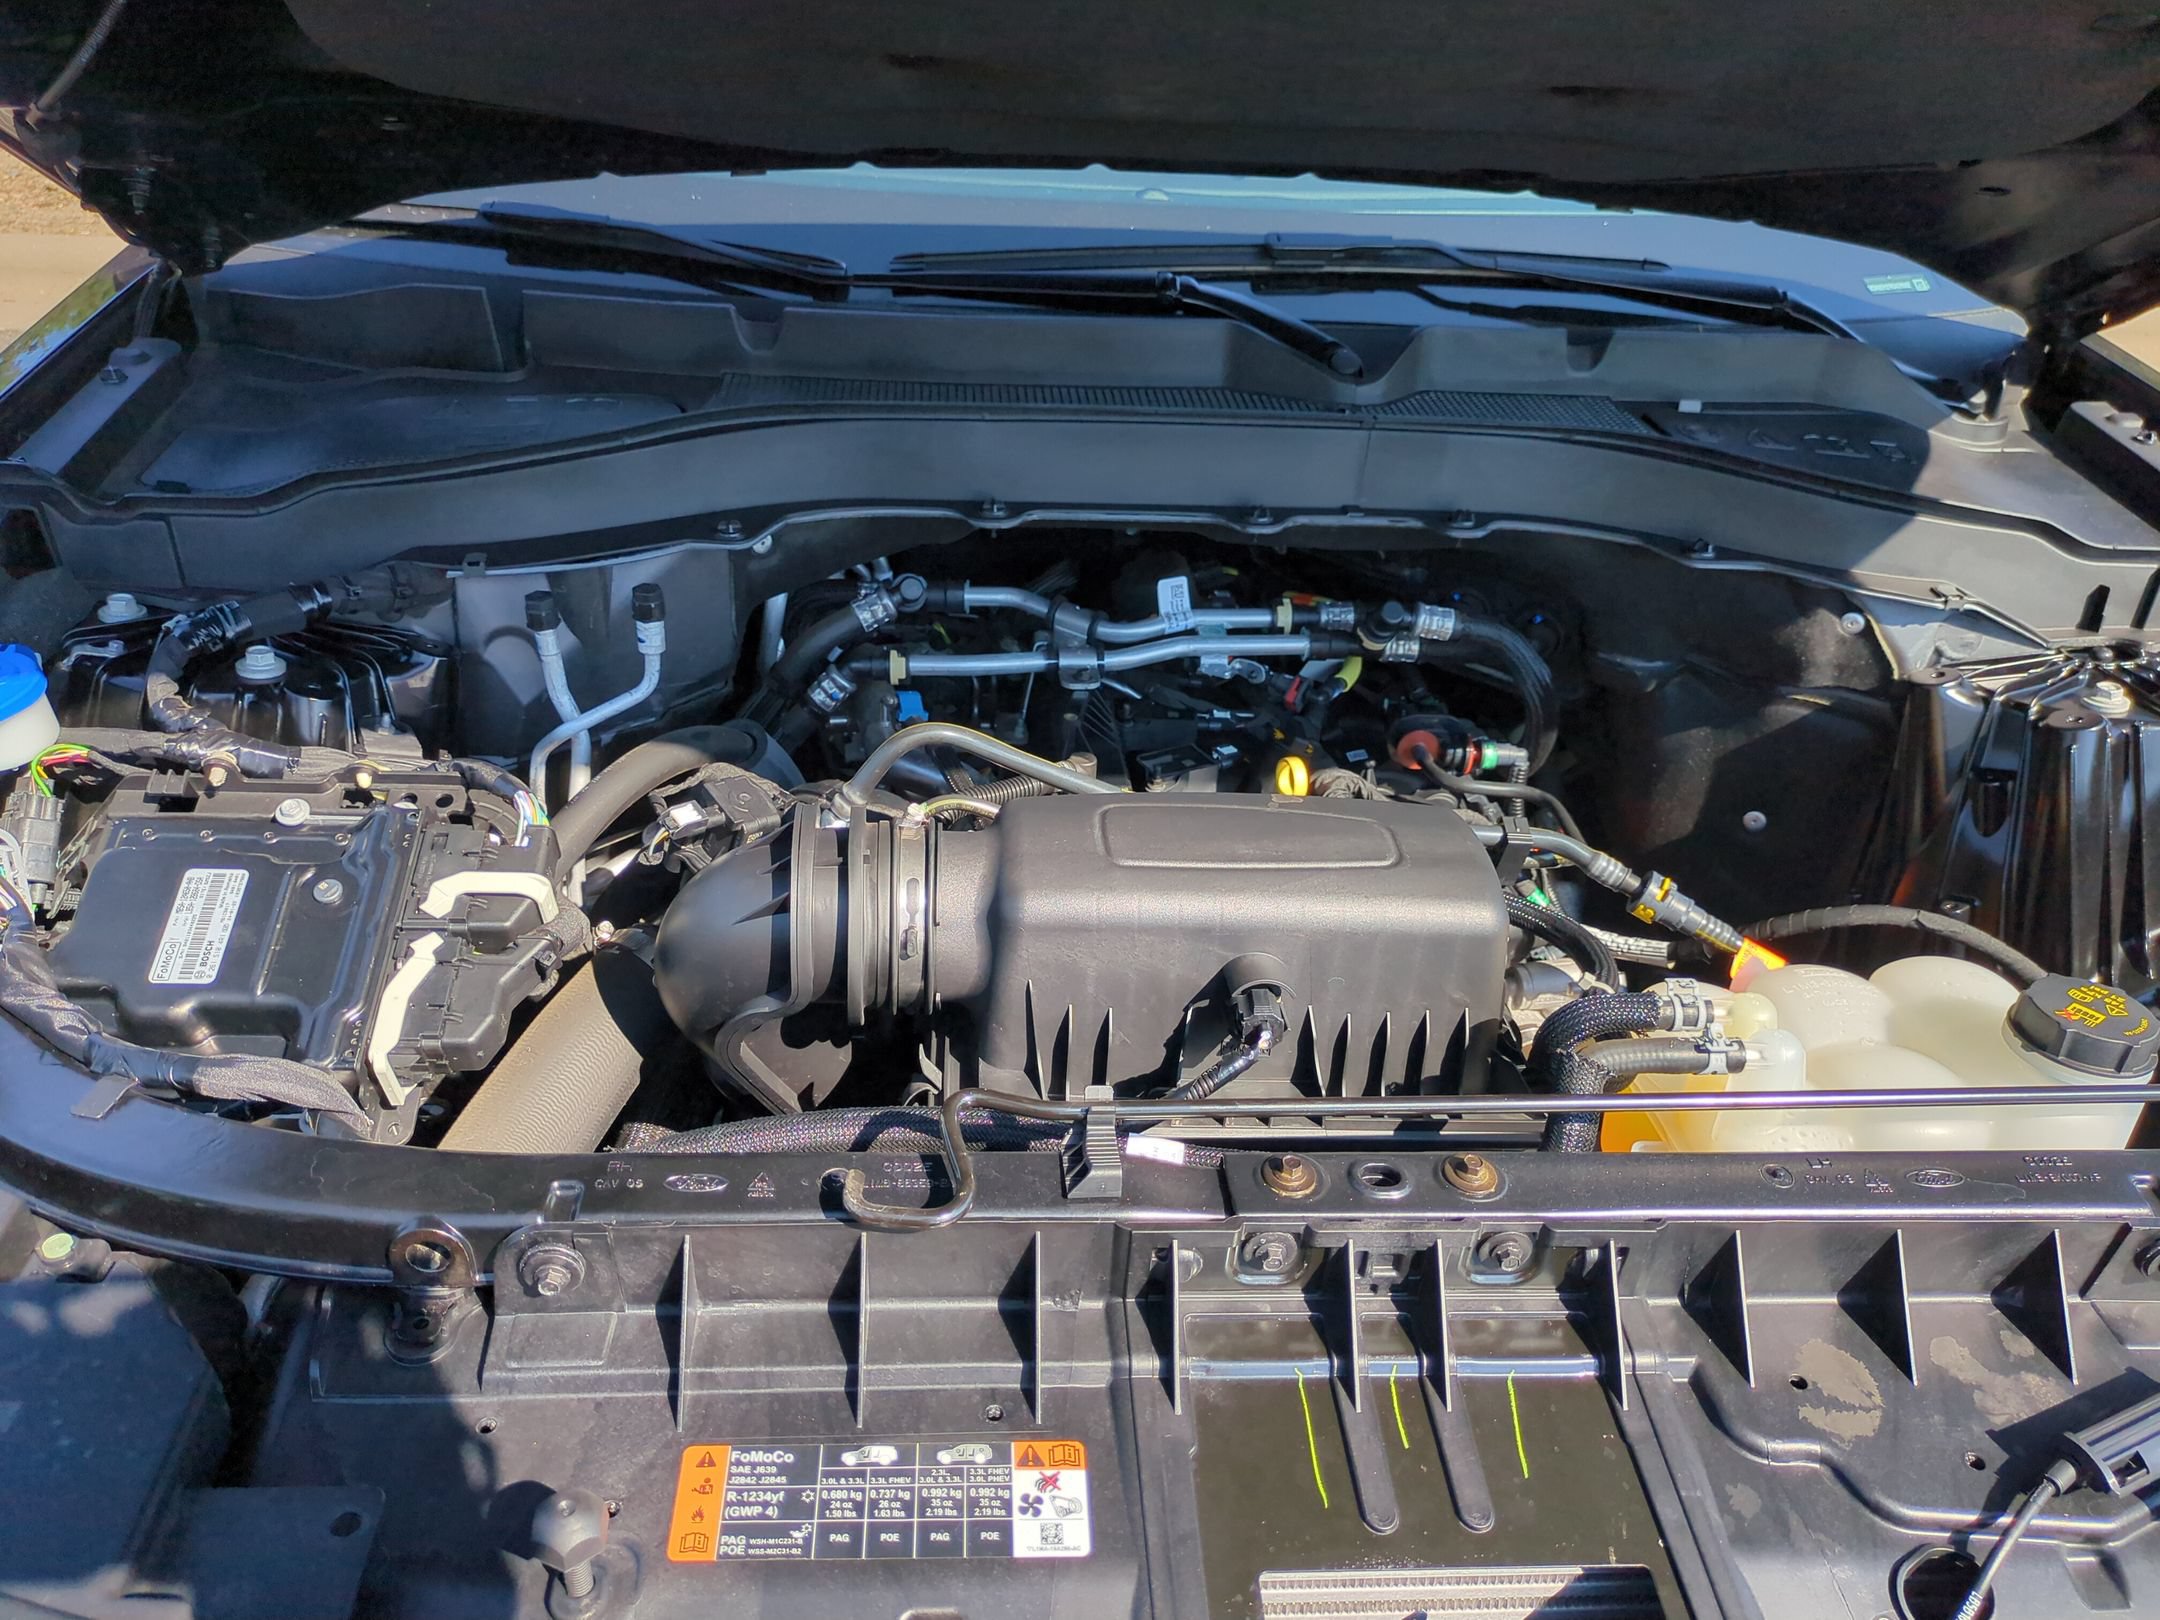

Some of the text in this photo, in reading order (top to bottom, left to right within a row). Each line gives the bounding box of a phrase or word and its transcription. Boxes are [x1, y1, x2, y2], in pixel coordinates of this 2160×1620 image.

[200, 940, 215, 967] BOSCH
[157, 944, 176, 979] FoMoCo
[730, 1451, 794, 1463] FoMoCo
[729, 1476, 757, 1484] J2842
[726, 1491, 784, 1503] R-1234yf
[822, 1490, 862, 1501] 0.680 kg
[870, 1489, 910, 1500] 0.737 kg
[922, 1488, 962, 1498] 0.992 kg
[970, 1488, 1009, 1498] 0.992 kg
[879, 1500, 889, 1508] 26
[725, 1506, 778, 1519] (GWP 4)
[721, 1536, 746, 1545] PAG
[829, 1534, 850, 1542] PAG
[930, 1532, 950, 1541] PAG
[980, 1532, 1000, 1540] POE
[719, 1546, 746, 1555] POE
